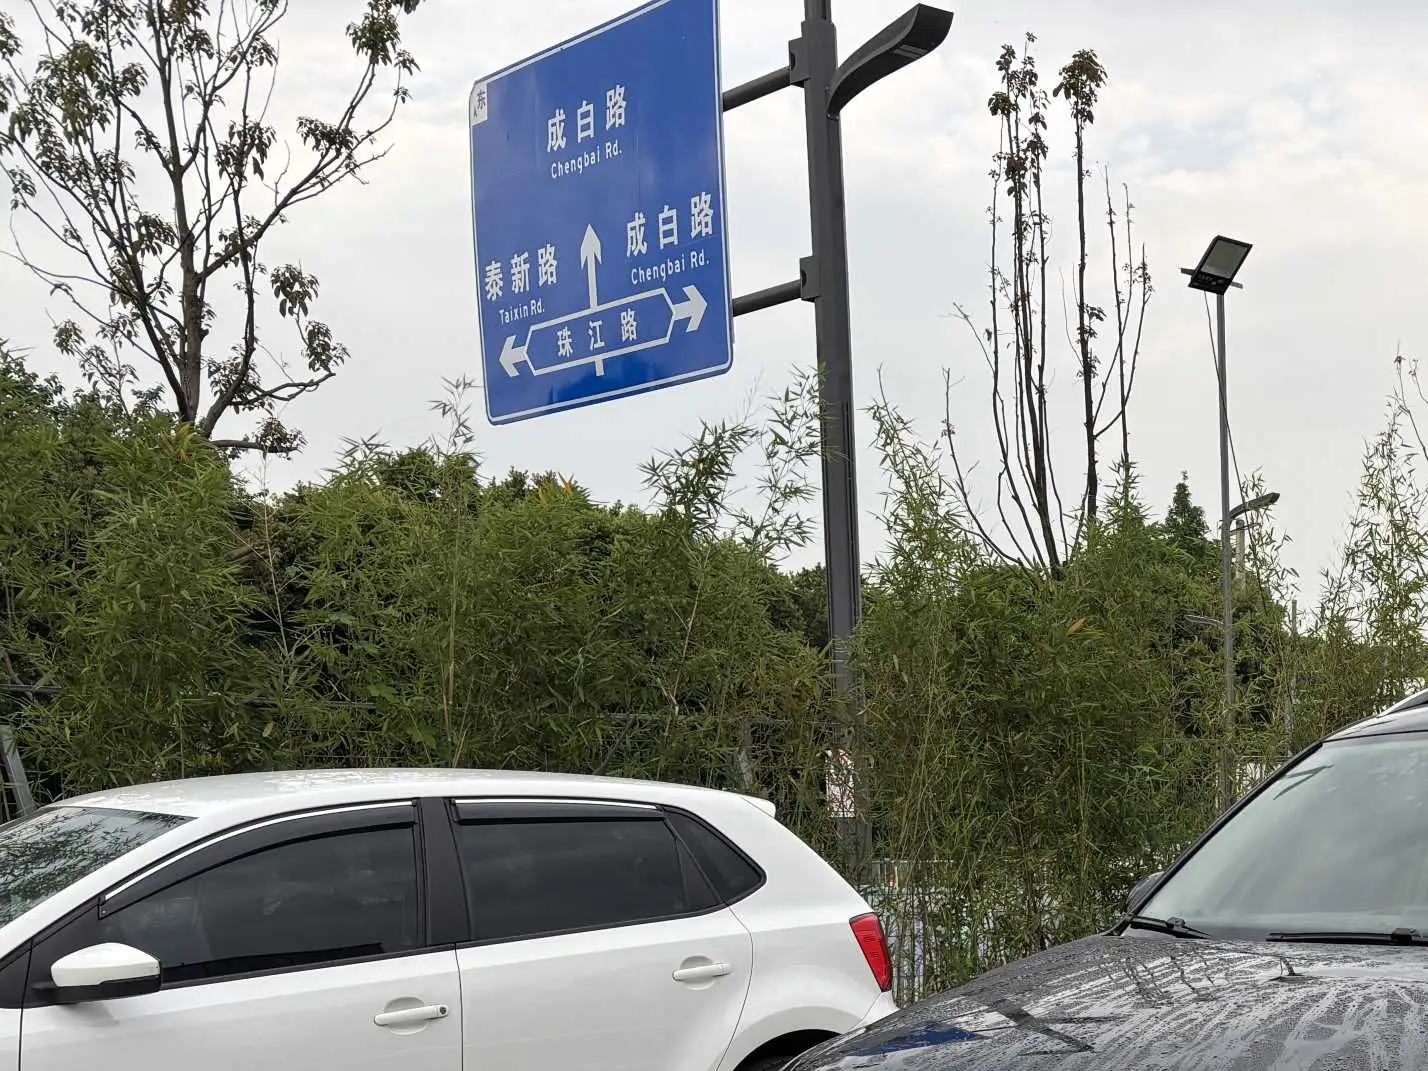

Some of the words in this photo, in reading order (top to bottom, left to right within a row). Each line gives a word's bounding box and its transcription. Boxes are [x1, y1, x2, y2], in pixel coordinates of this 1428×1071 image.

[547, 84, 627, 153] 成白路
[551, 145, 601, 179] Chengbai
[605, 139, 623, 159] Rd.
[626, 191, 714, 258] 成白路
[484, 243, 558, 302] 泰新路
[631, 253, 686, 285] Chengbai
[690, 249, 711, 269] Rd.
[498, 303, 529, 325] Taixin
[530, 298, 545, 316] Rd.
[557, 307, 638, 358] 珠江路
